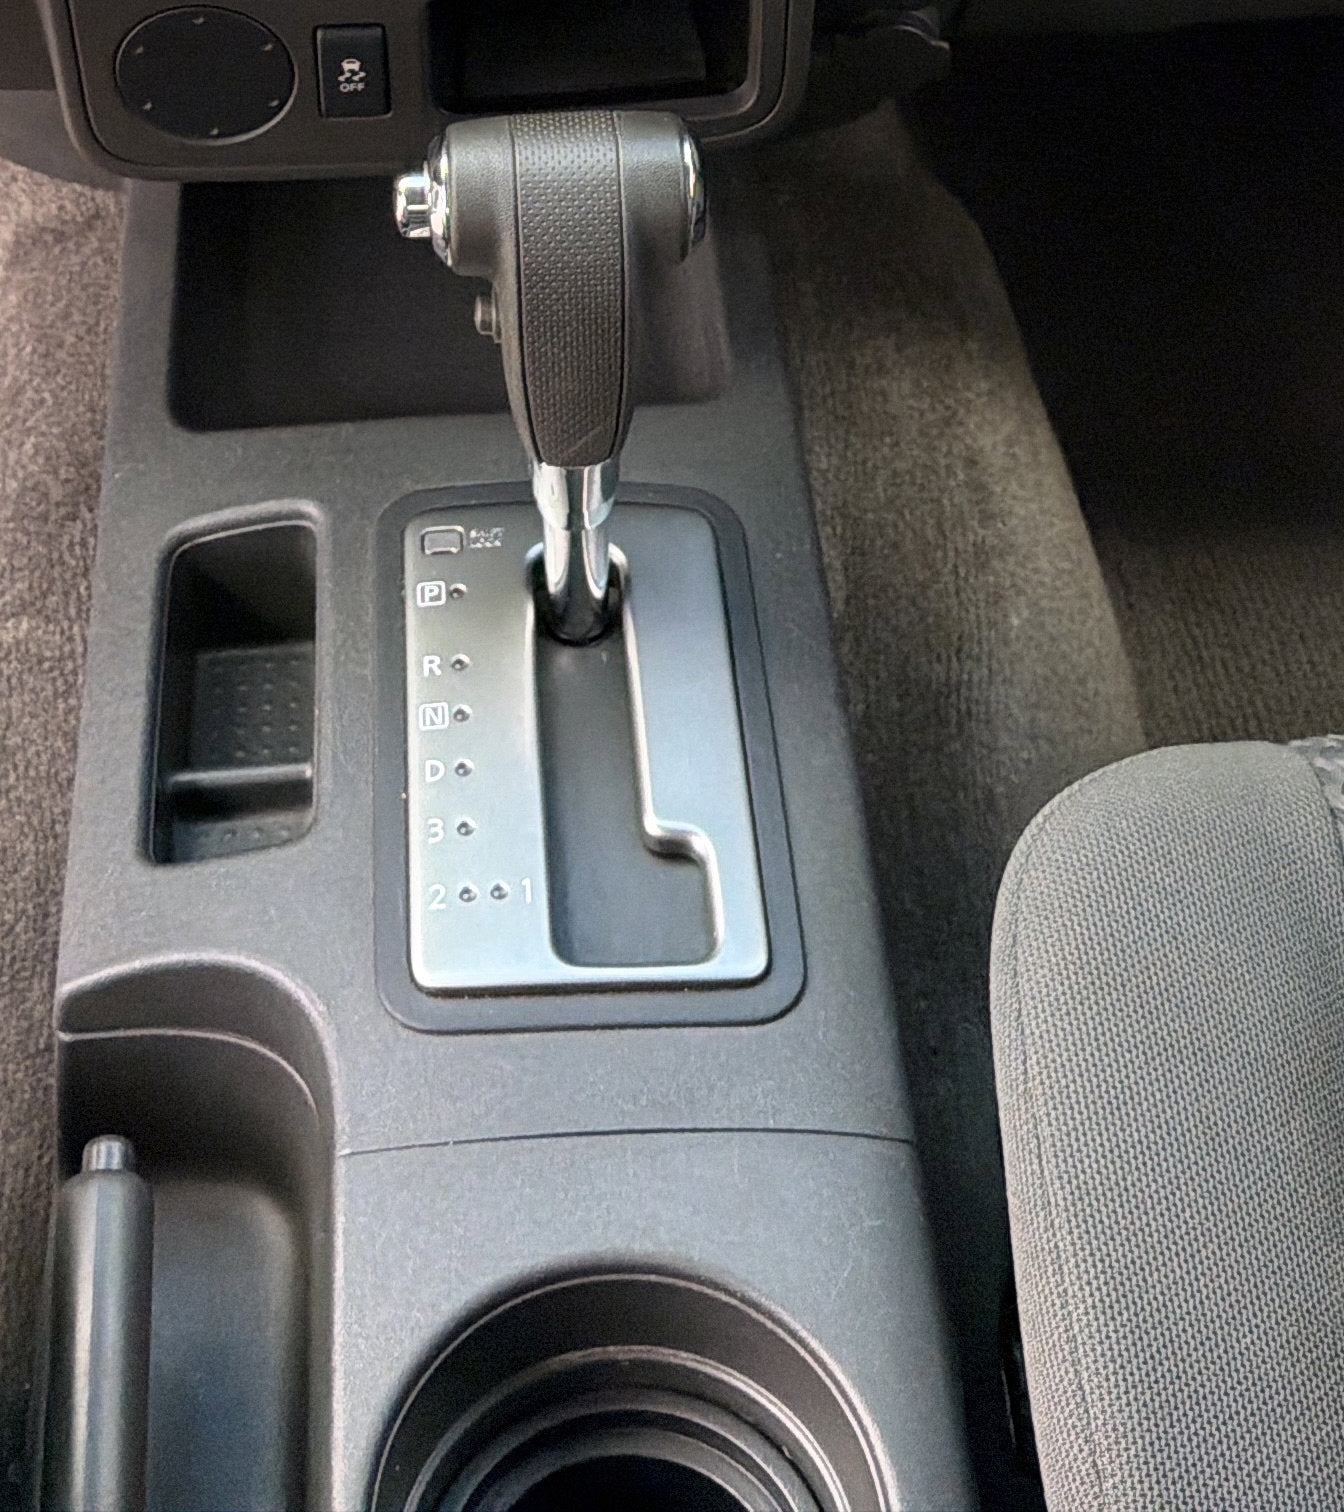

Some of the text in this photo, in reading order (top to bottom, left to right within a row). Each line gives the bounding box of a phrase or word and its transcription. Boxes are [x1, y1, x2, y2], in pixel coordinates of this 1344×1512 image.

[340, 83, 365, 92] OFF
[423, 655, 441, 676] R
[425, 759, 445, 782] D
[426, 819, 445, 844] 3
[428, 878, 532, 910] 2 1
